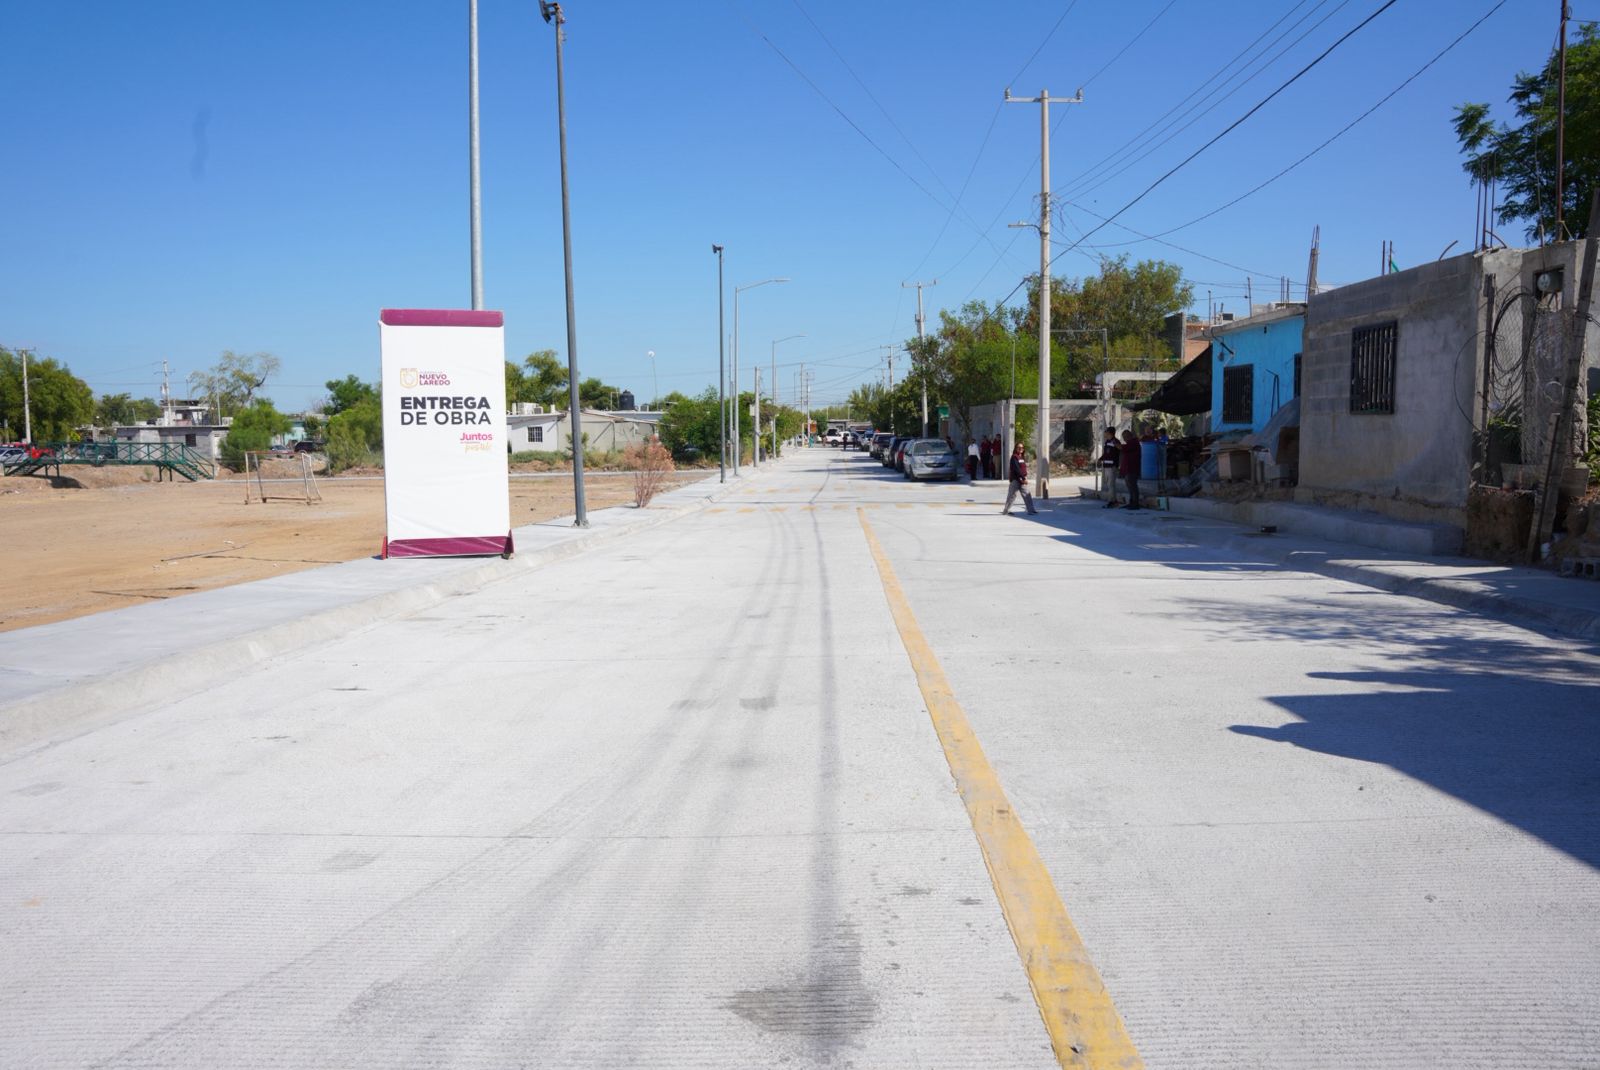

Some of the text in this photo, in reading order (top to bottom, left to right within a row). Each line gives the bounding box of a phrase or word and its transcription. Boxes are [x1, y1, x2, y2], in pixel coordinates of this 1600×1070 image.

[400, 396, 491, 410] ENTREGA
[401, 411, 491, 425] DE OBRA
[460, 432, 493, 441] Juntos
